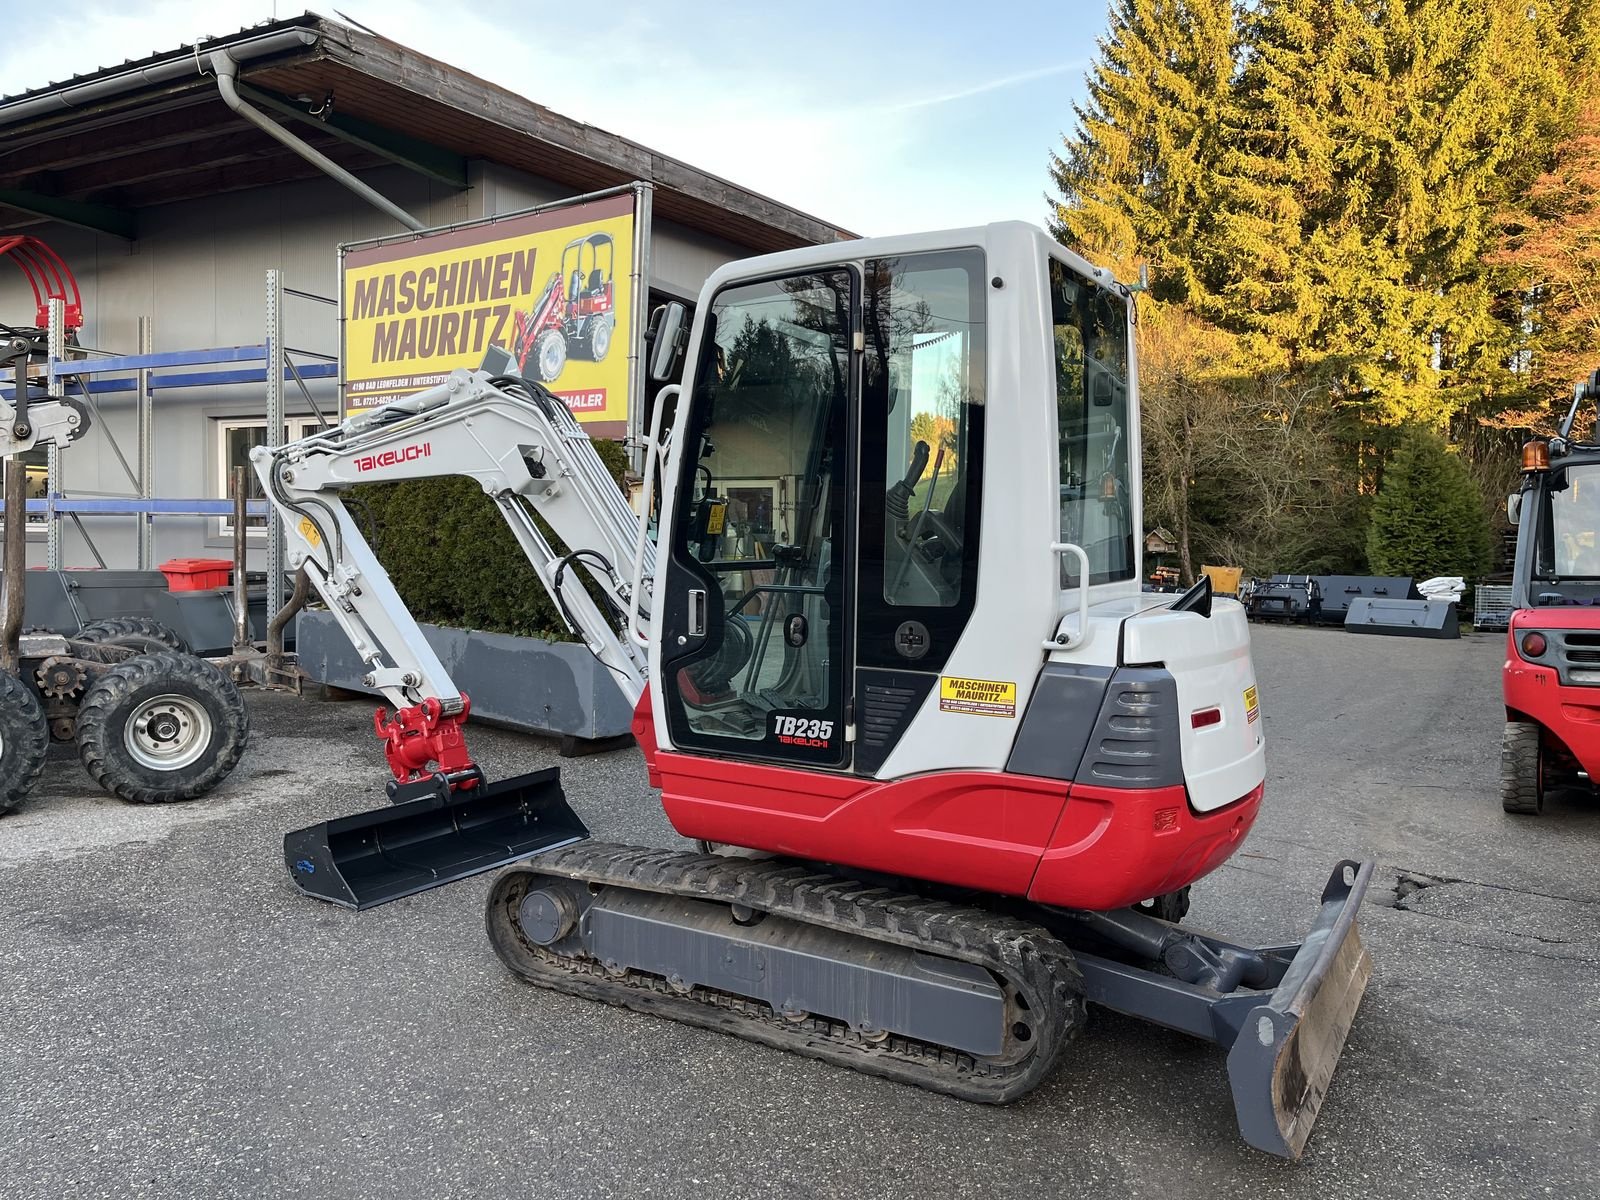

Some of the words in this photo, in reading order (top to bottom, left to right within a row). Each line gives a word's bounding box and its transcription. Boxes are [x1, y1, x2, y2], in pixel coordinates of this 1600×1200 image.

[352, 247, 537, 320] MASCHINEN
[372, 304, 511, 364] MAURITZ
[352, 382, 365, 391] 4190
[365, 381, 377, 390] BAD
[376, 377, 409, 389] LEONFELDEN
[412, 374, 448, 386] UNTERSTIFTU
[352, 397, 363, 407] TEL.
[949, 679, 1008, 693] MASCHINEN
[956, 690, 1001, 702] MAURITZ
[774, 715, 834, 740] TB235
